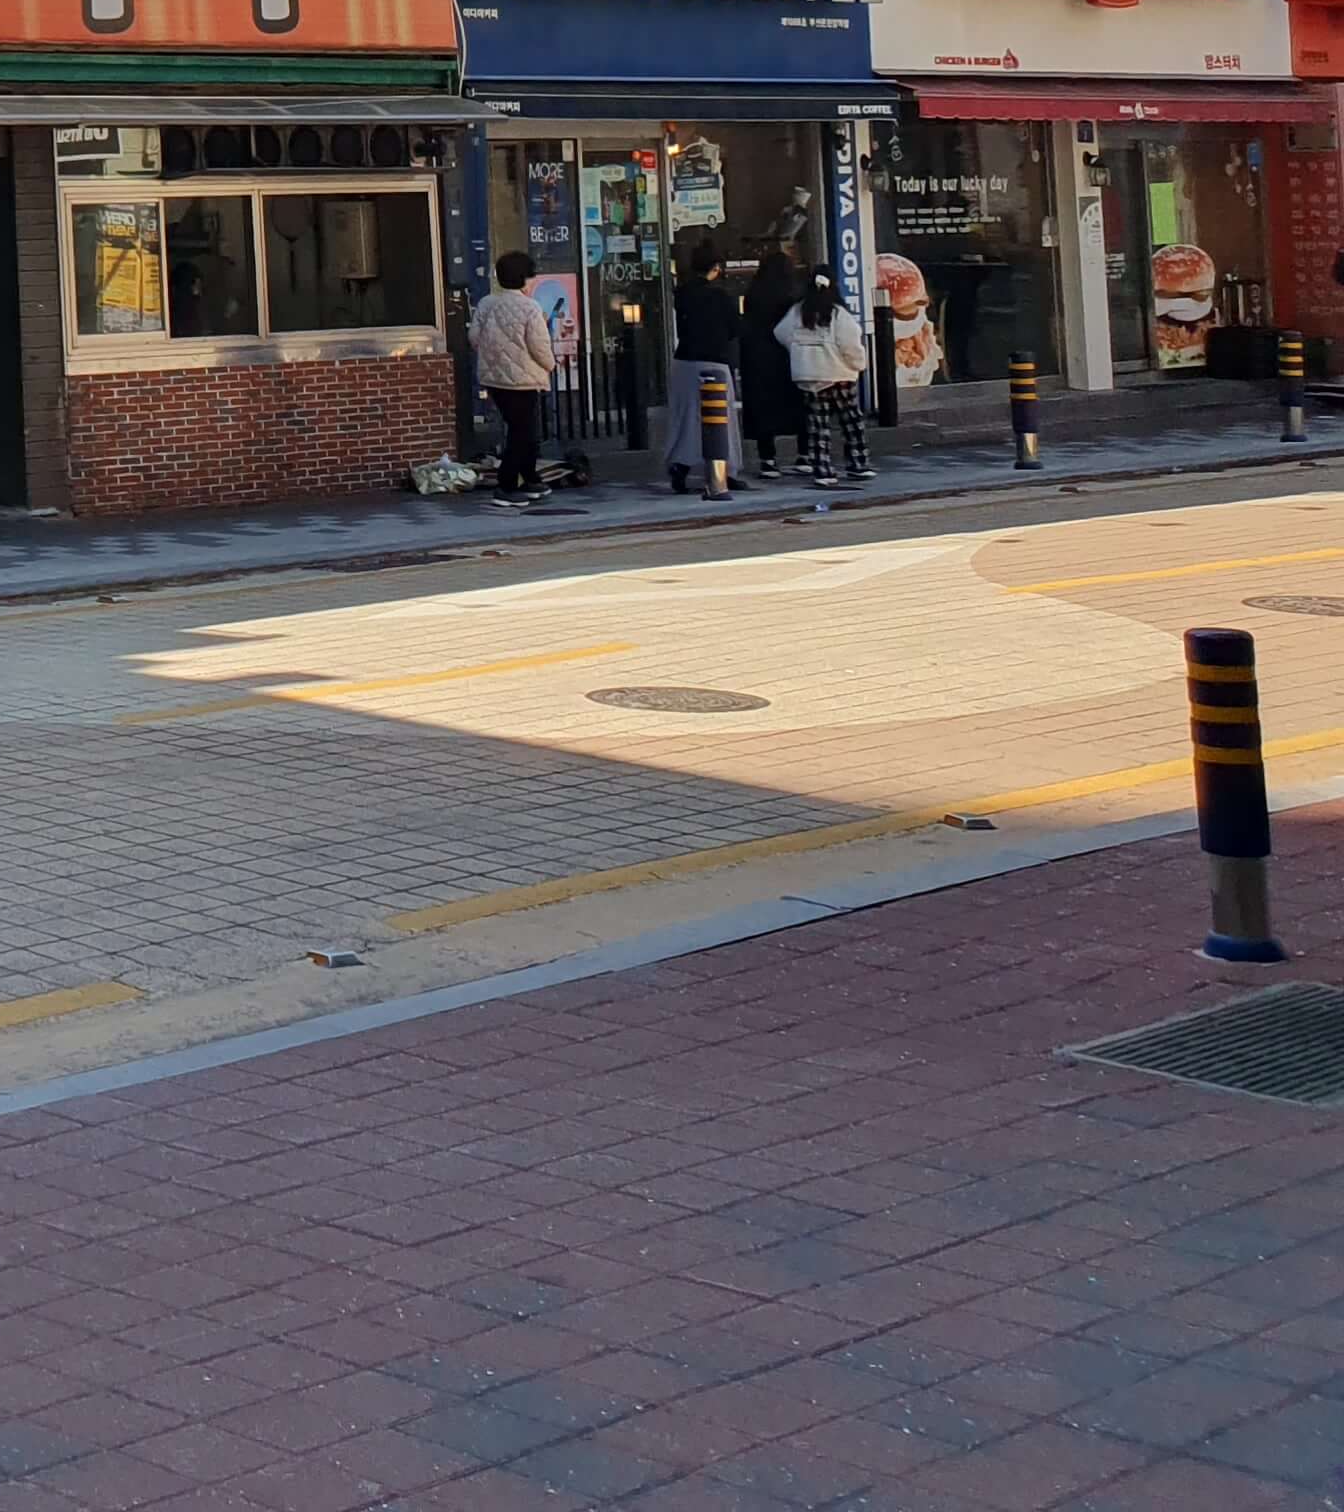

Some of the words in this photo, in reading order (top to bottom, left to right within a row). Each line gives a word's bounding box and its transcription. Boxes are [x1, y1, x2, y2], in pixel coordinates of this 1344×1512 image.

[894, 175, 926, 195] Today
[929, 175, 939, 192] is
[990, 174, 1008, 193] day
